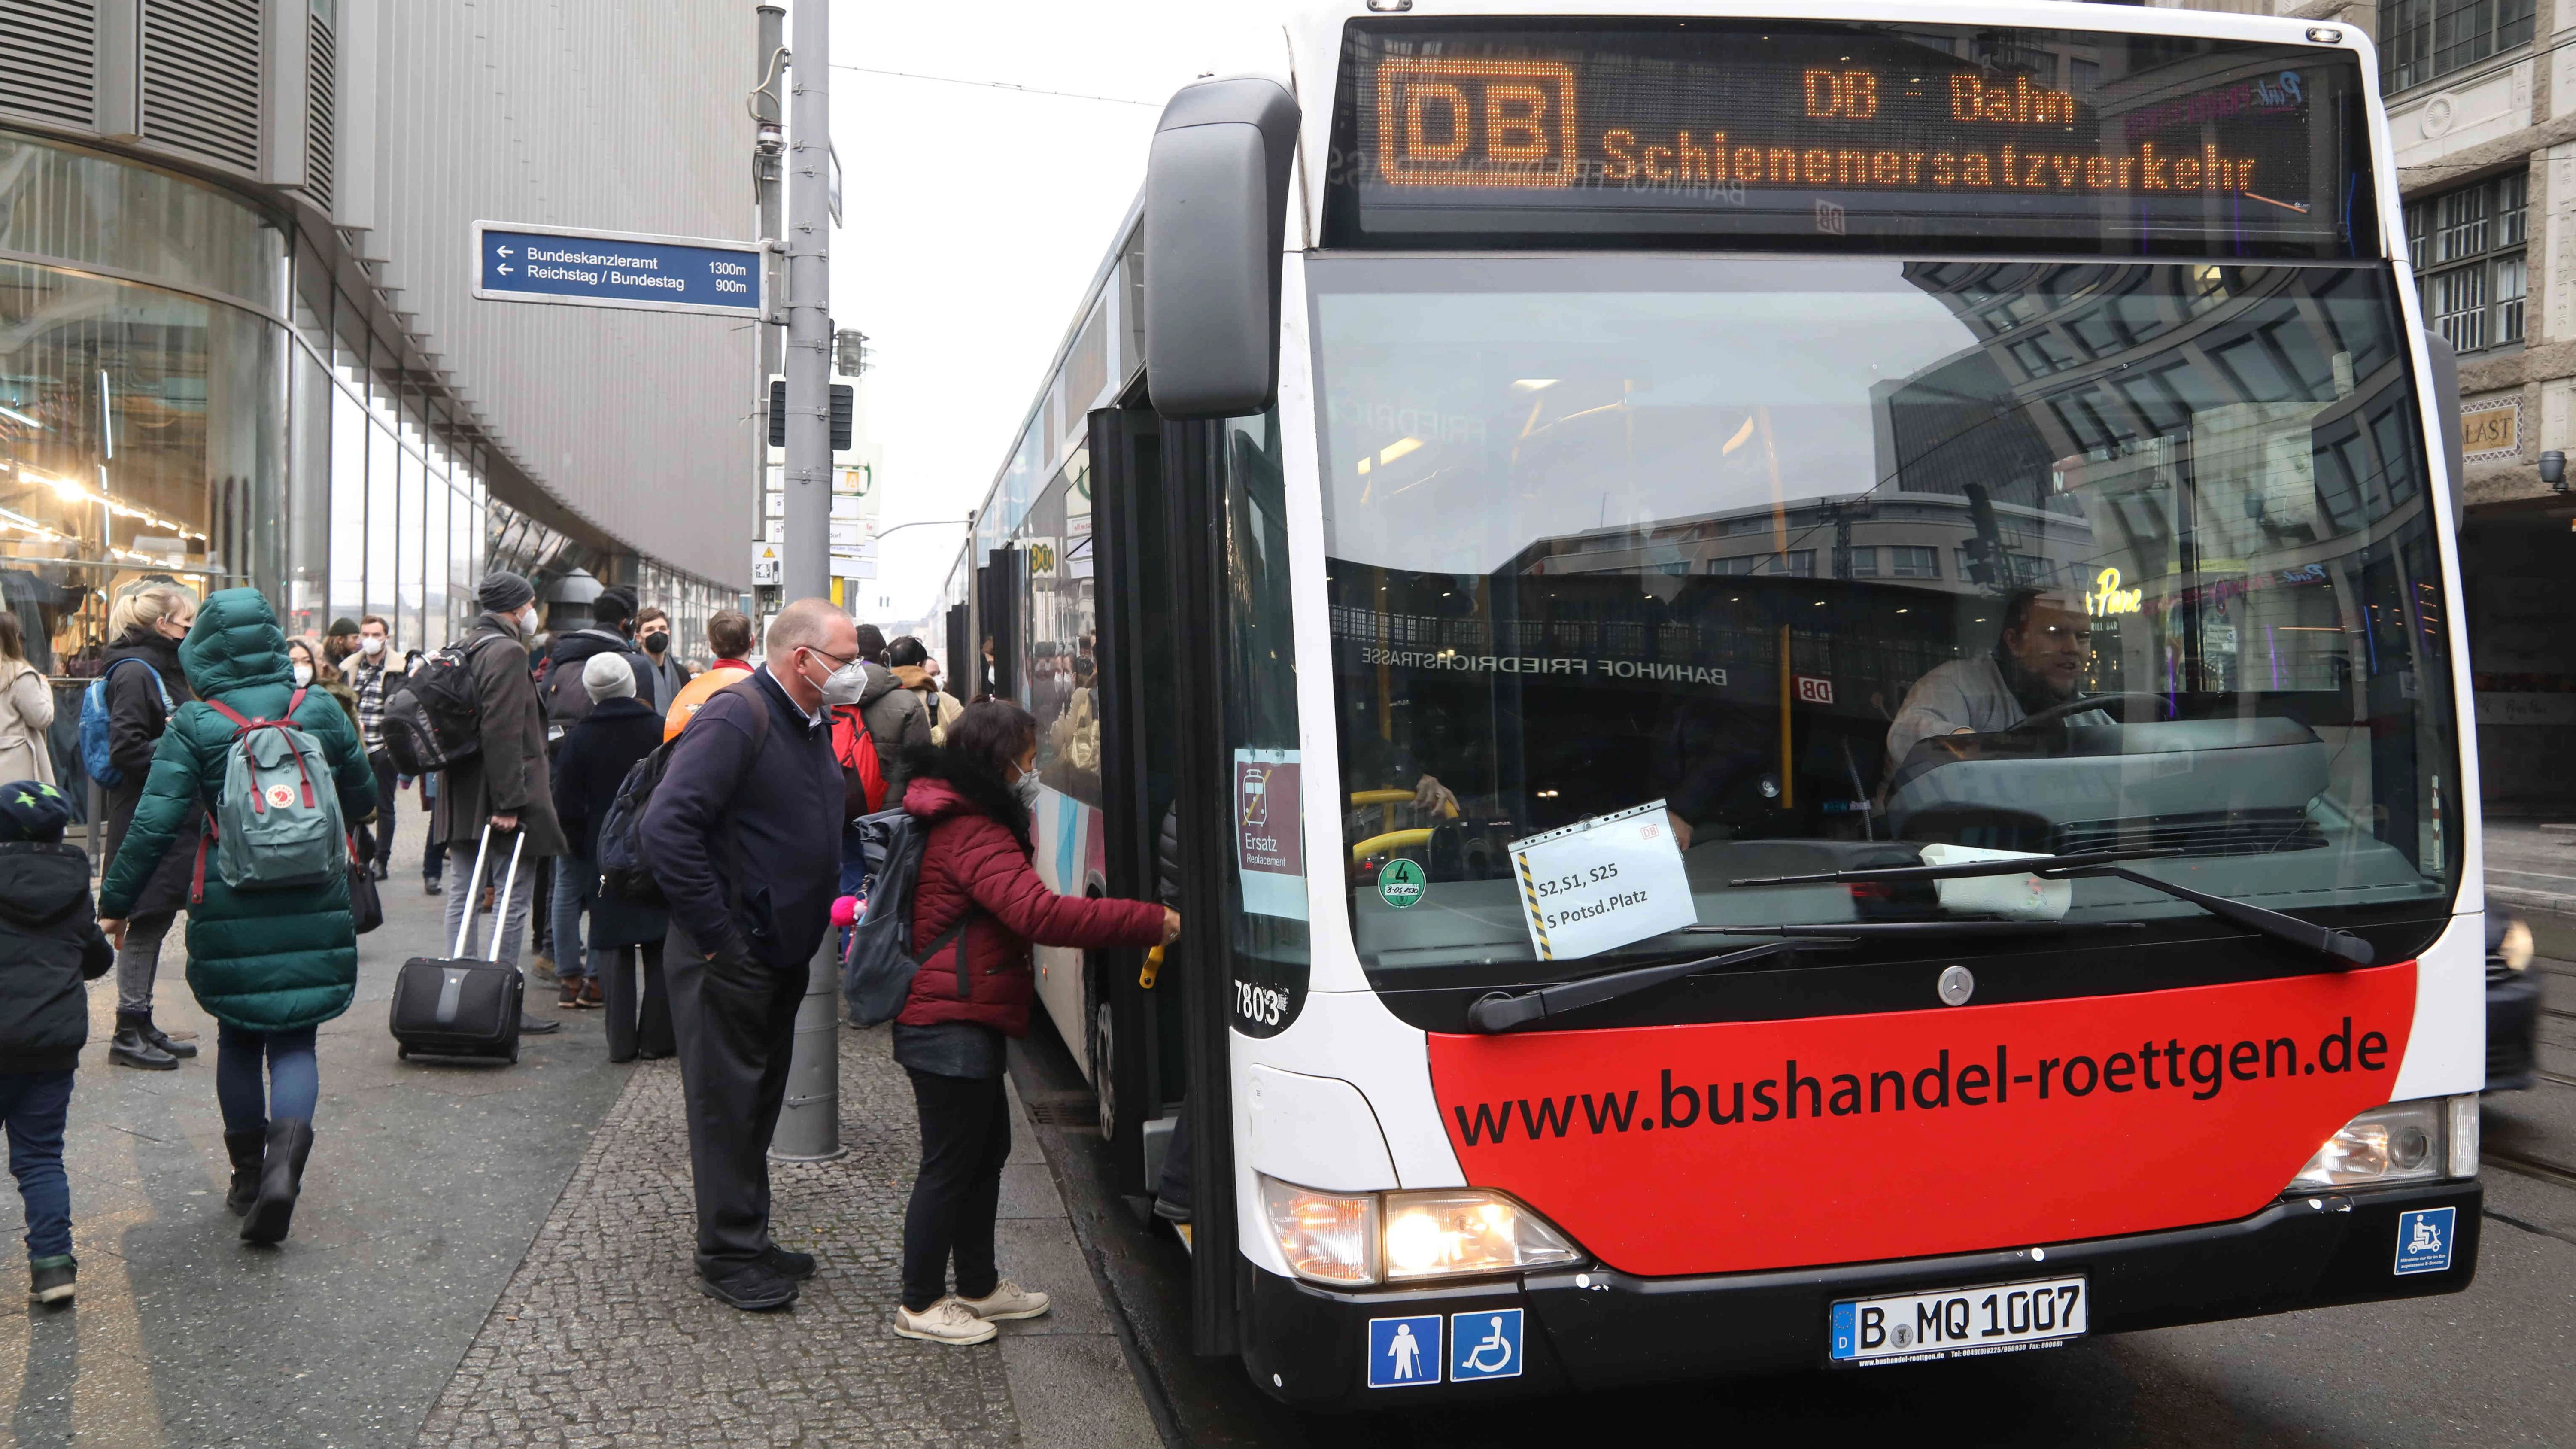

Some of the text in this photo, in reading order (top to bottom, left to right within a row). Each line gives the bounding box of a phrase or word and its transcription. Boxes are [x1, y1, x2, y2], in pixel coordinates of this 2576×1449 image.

[1806, 69, 1876, 120] DB
[1950, 73, 2074, 124] Bahn
[1405, 82, 1548, 162] DB
[1603, 129, 2255, 191] Schienenersatzverkehr
[527, 246, 747, 276] Bundeskanzleramt 1300m
[527, 265, 747, 293] Reichstag / Bundestag 900m
[2462, 418, 2512, 444] LAST
[2094, 568, 2142, 617] Pane
[2090, 622, 2103, 631] RILL
[1245, 832, 1277, 852] Ersatz
[1643, 827, 1657, 838] DB
[1247, 853, 1286, 867] Replacement
[1395, 862, 1409, 883] 4
[1538, 863, 1618, 897] S2,S1, S25
[1547, 890, 1648, 929] S Potsd.Platz
[1235, 979, 1279, 1026] 7803
[1454, 1016, 2388, 1147] www.bushandel-roettgen.de
[1861, 1307, 1886, 1349] B
[1917, 1297, 1970, 1344] MQ
[1982, 1285, 2080, 1337] 1007
[1839, 1337, 1847, 1349] D
[1859, 1352, 1944, 1367] www.bushandel-roettgen.de
